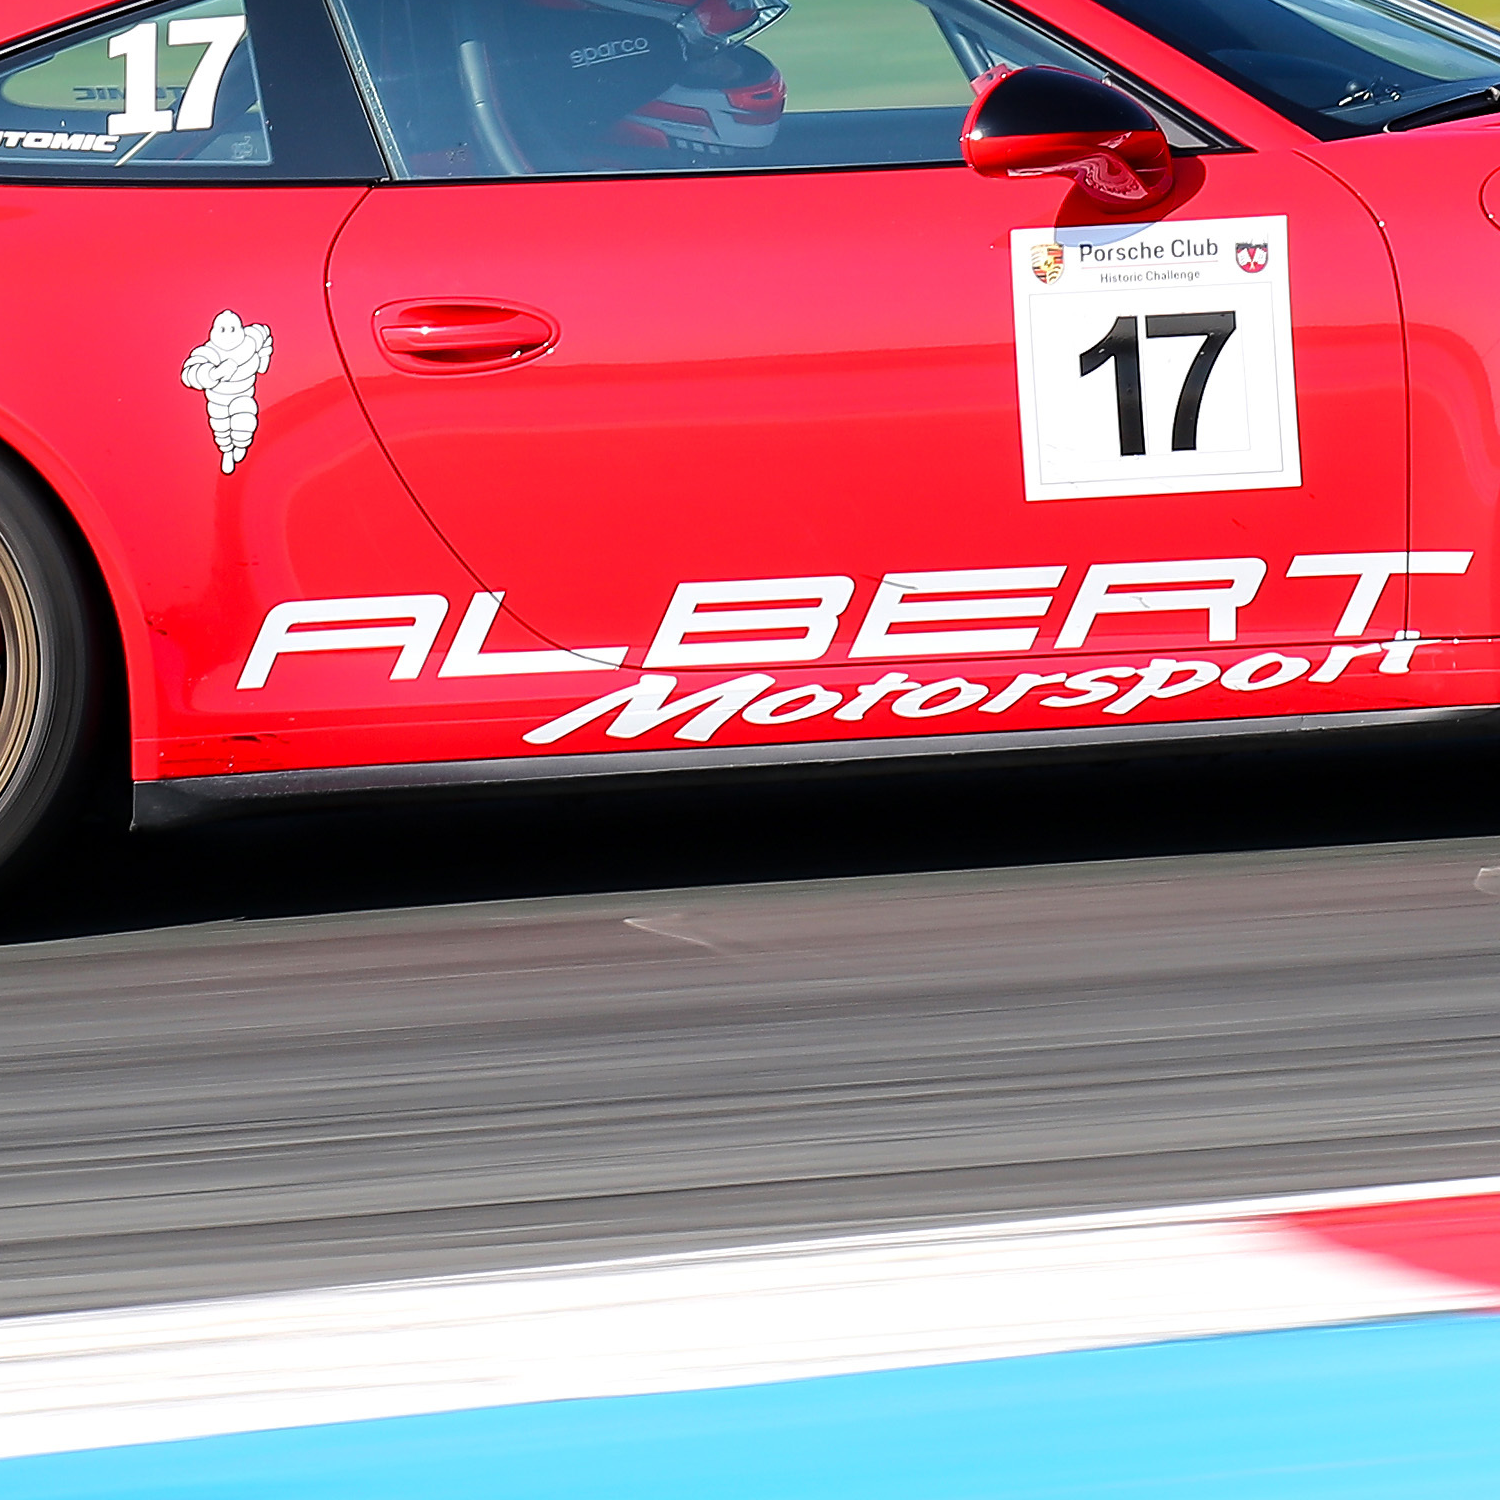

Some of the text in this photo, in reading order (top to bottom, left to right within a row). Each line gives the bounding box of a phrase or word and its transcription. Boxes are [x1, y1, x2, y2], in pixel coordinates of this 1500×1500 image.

[107, 14, 248, 136] 17
[570, 37, 648, 67] sparco
[1080, 239, 1218, 262] Porsche Club
[1100, 269, 1200, 284] Historic Challenge
[1079, 310, 1236, 456] 17
[236, 551, 1474, 690] ALBERT
[522, 630, 1442, 744] Motorsport
